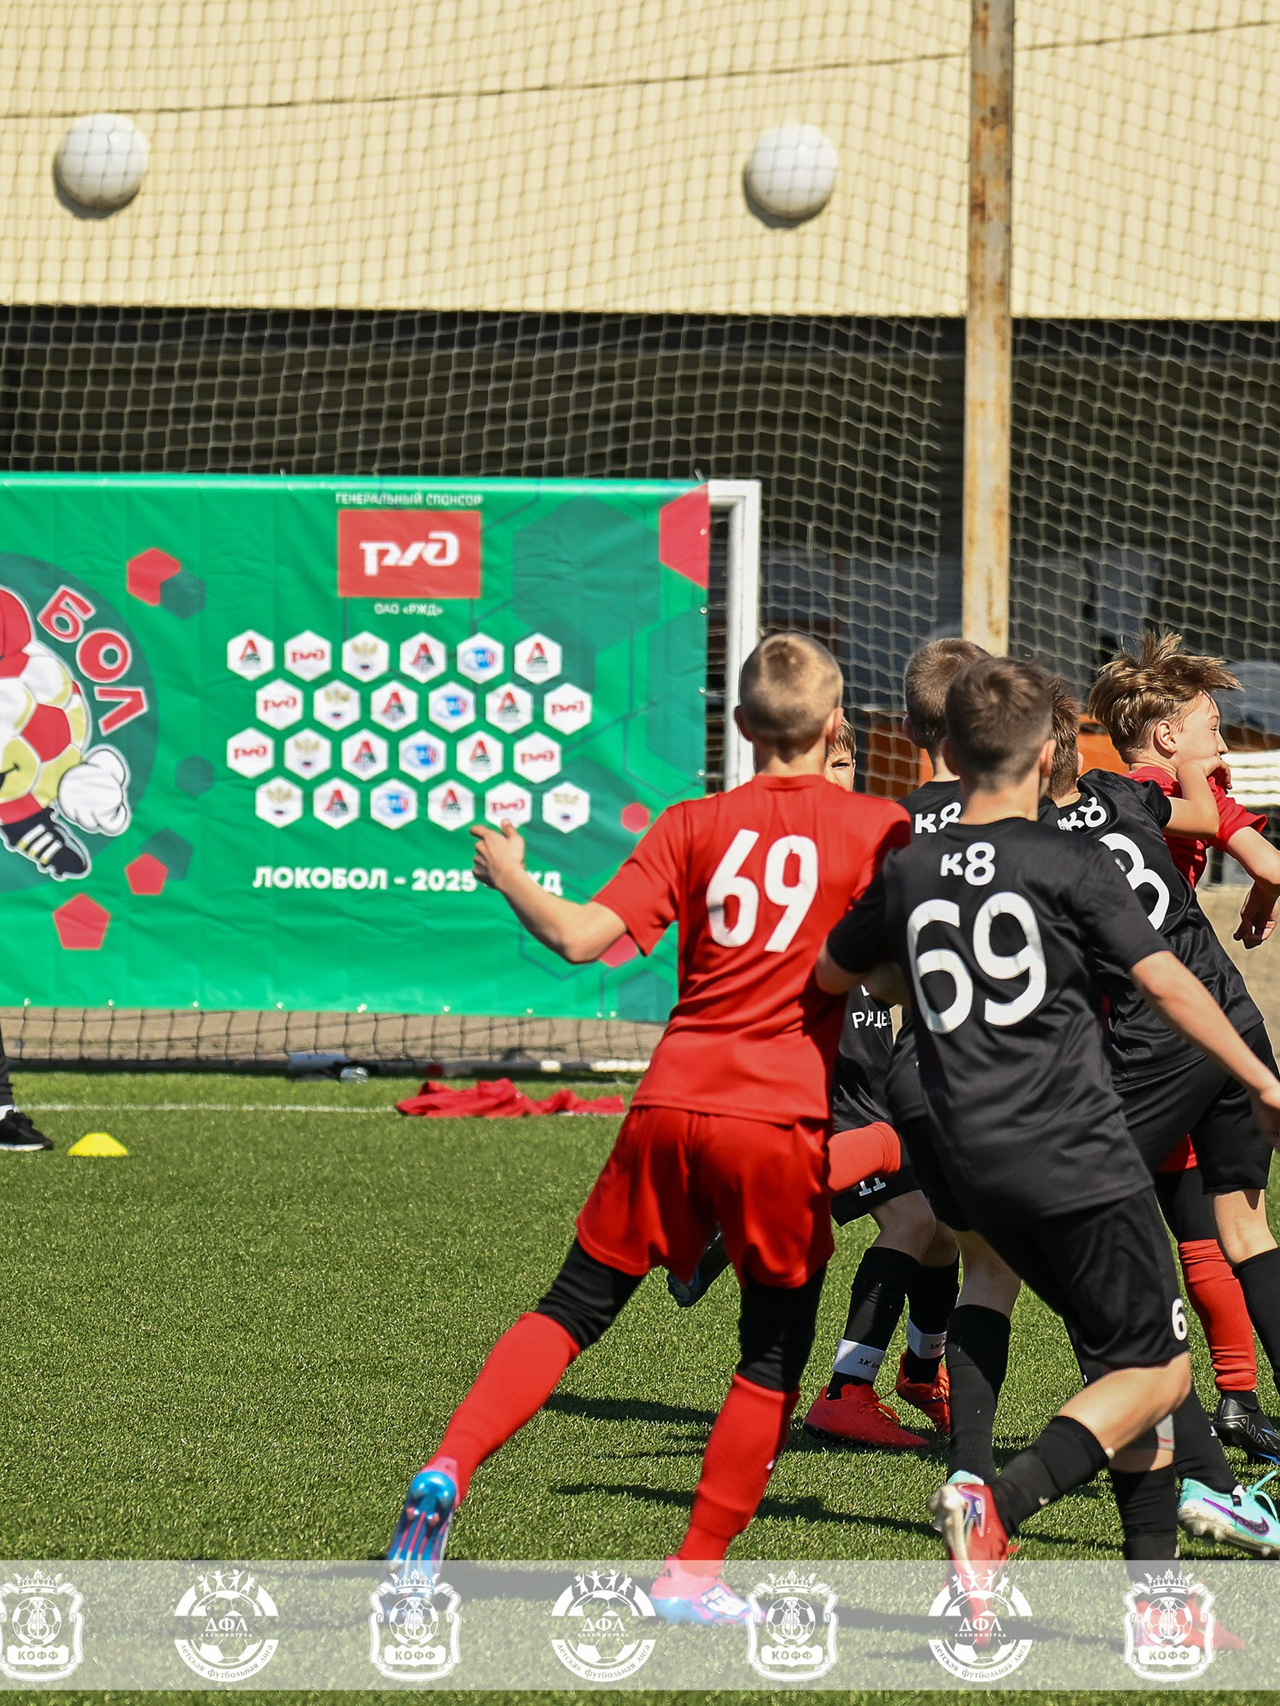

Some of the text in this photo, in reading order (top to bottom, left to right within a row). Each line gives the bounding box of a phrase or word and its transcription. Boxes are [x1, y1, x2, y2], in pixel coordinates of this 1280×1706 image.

[335, 491, 483, 506] ГЕНЕРАЛЬНЫЙ СПОНСОР
[374, 602, 399, 615] ОАО
[253, 866, 387, 890] ЛОКОБОЛ
[411, 869, 478, 892] 2025
[705, 829, 819, 954] 69
[906, 891, 1047, 1034] 69
[1172, 1298, 1188, 1341] 6
